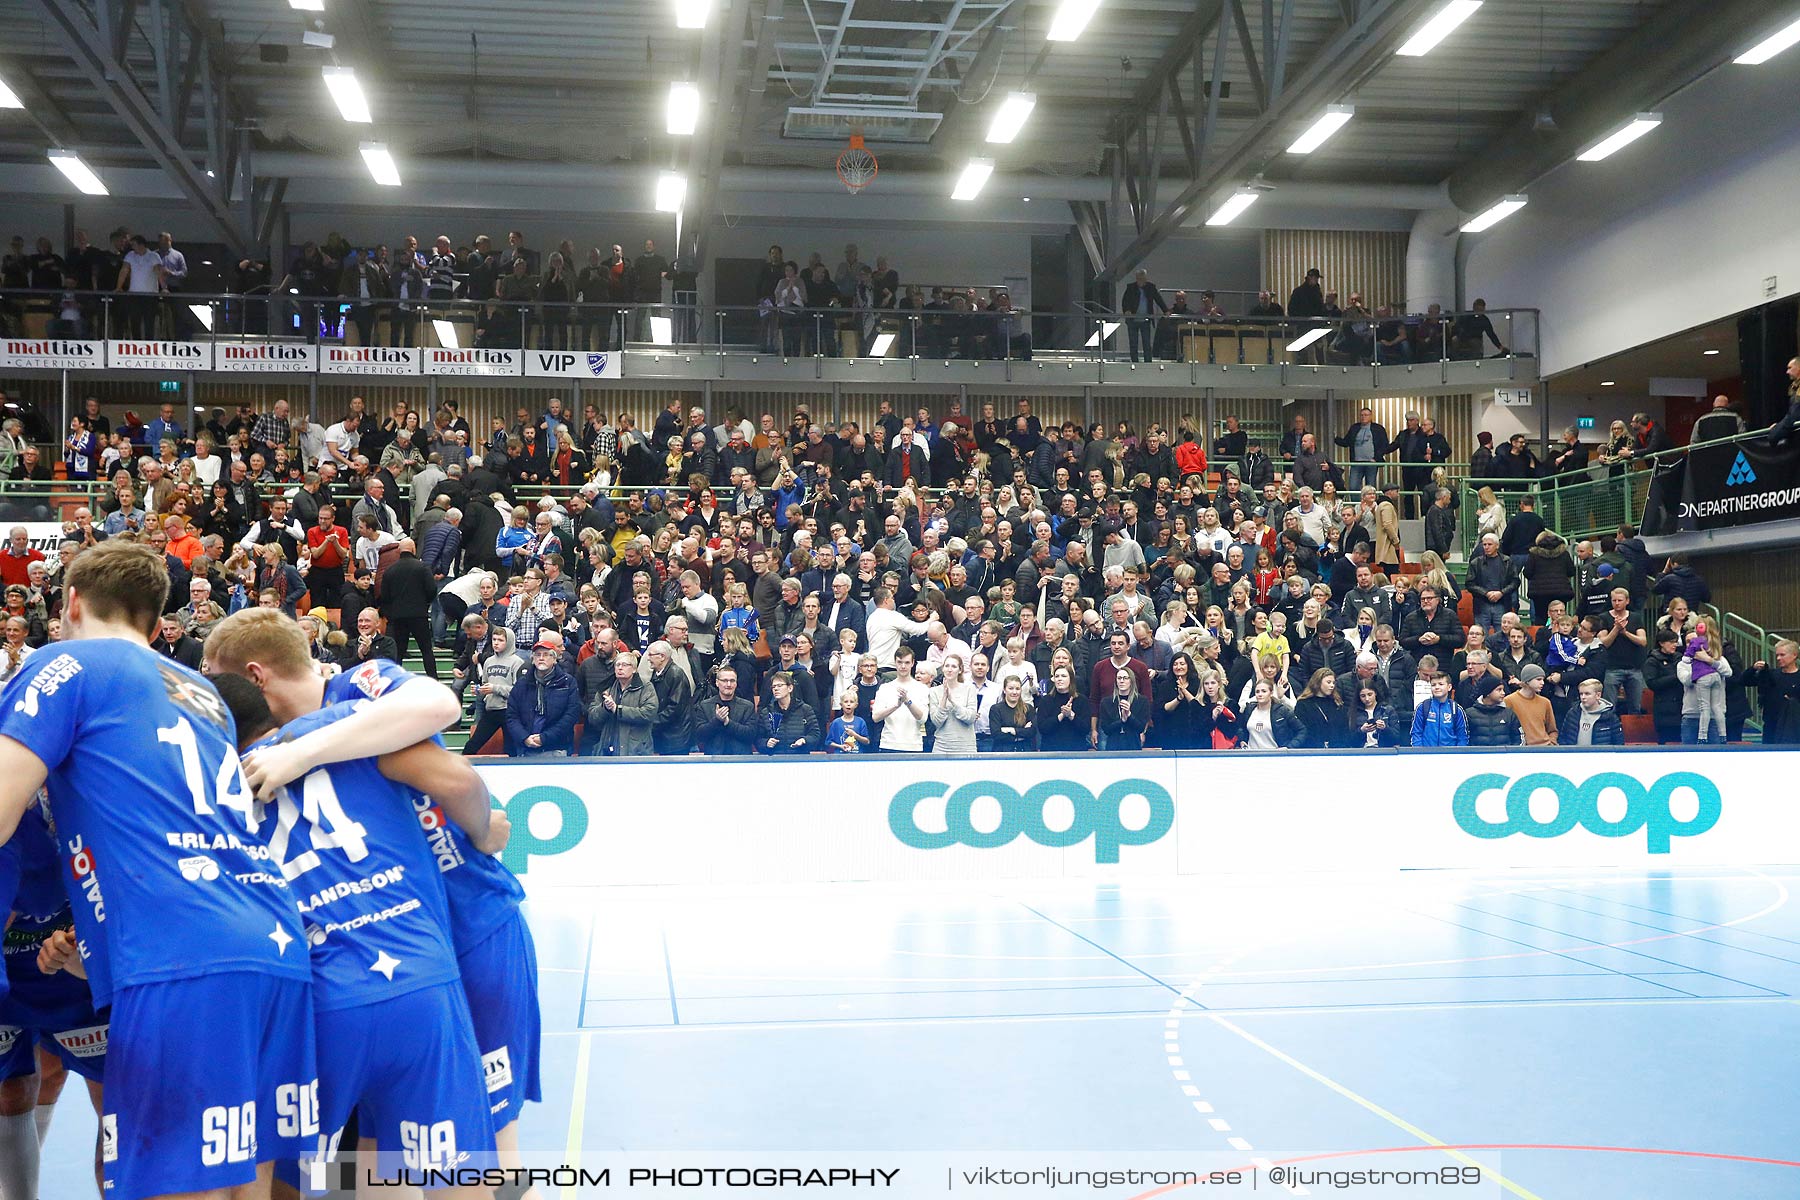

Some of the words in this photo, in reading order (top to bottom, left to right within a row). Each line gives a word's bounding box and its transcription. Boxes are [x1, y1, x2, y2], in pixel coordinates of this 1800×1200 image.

[8, 341, 94, 356] mattias
[118, 343, 201, 357] mattias
[225, 344, 307, 359] mattias
[329, 348, 411, 363] mattias
[433, 349, 512, 364] mattias
[15, 359, 87, 368] CATERING
[125, 360, 195, 369] CATERING
[232, 362, 301, 371] CATERING
[337, 365, 404, 374] CATERING
[439, 366, 506, 375] CATERING
[538, 354, 576, 372] VIP
[1518, 391, 1529, 403] H
[31, 653, 77, 689] INTER
[41, 659, 83, 696] SPORT
[156, 716, 260, 835] 14
[1452, 771, 1722, 854] coop
[253, 768, 369, 882] 24
[888, 778, 1175, 864] coop
[412, 795, 459, 873] DALOC
[296, 866, 404, 913] LANDSSON
[202, 1101, 256, 1167] SLA
[399, 1120, 457, 1173] SLA
